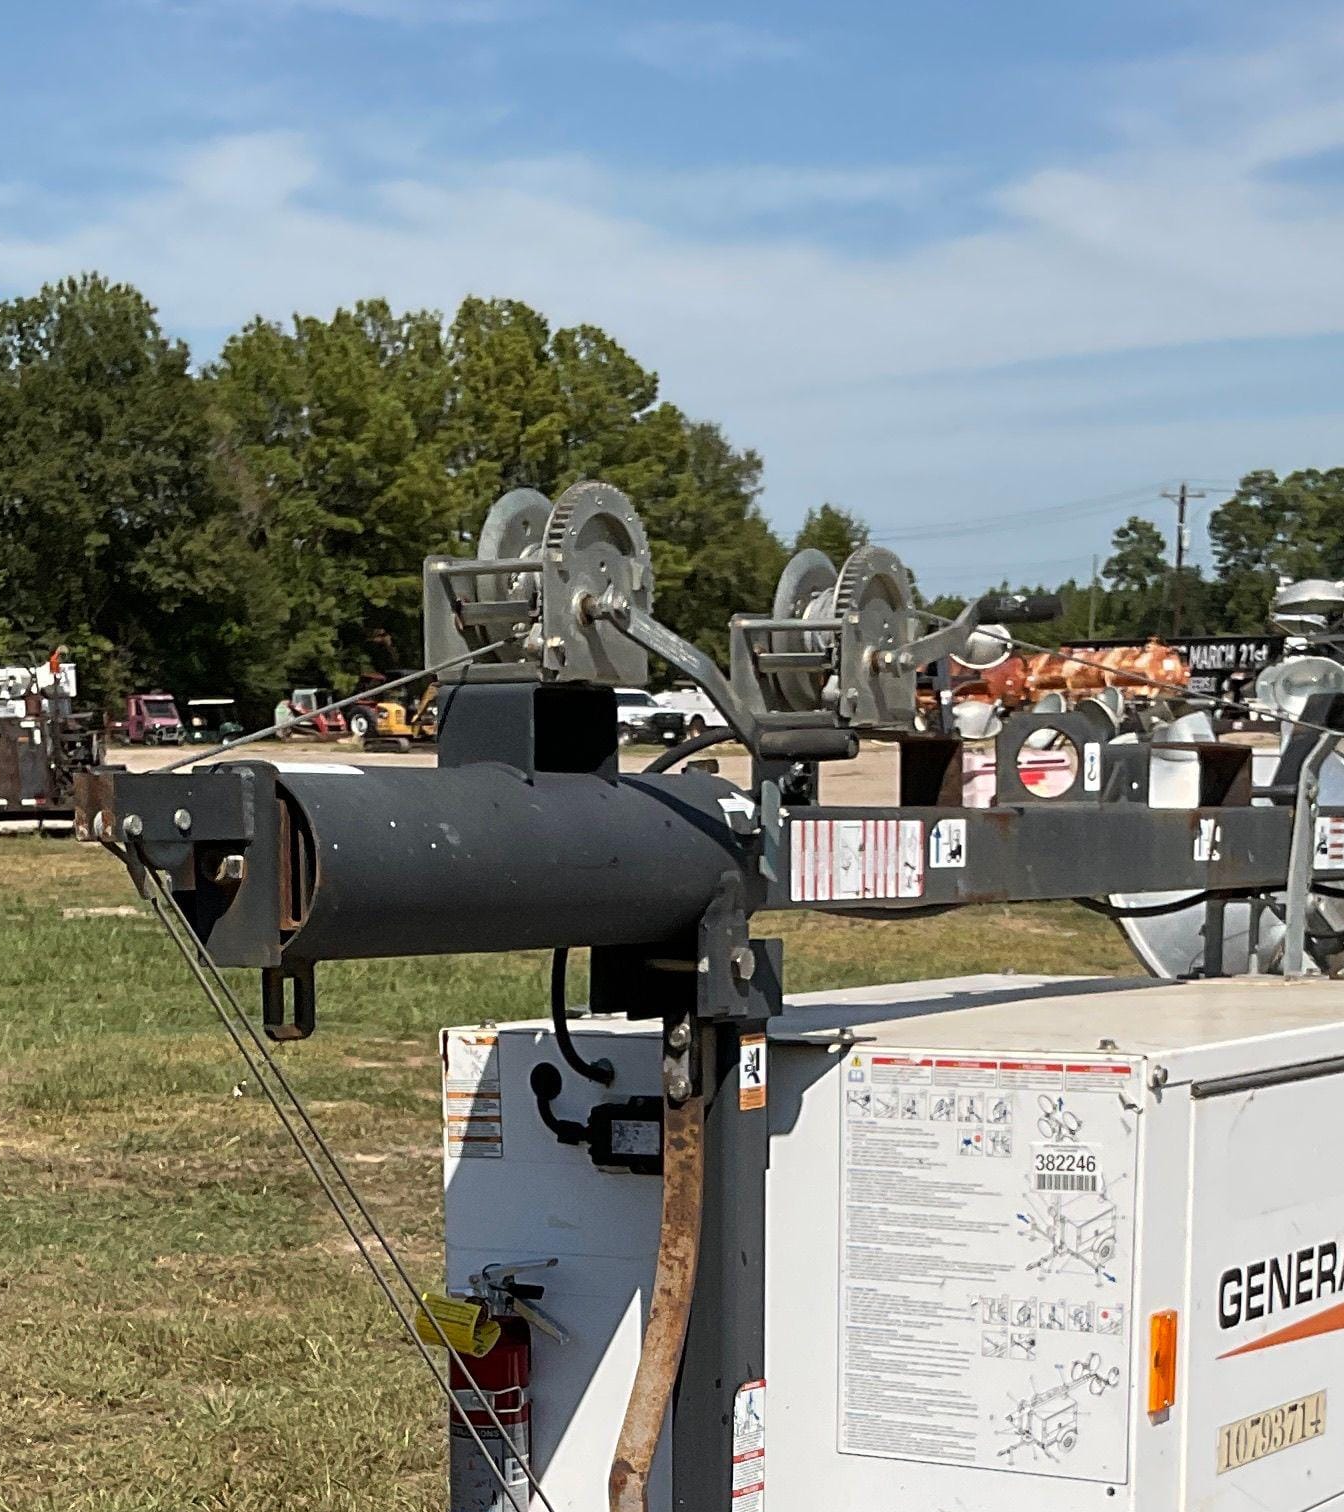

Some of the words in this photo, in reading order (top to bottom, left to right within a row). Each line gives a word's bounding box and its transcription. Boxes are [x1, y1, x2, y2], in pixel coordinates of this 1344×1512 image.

[1189, 644, 1236, 669] MARCH
[1035, 1154, 1096, 1172] 382246
[1224, 1395, 1322, 1468] 10793714
